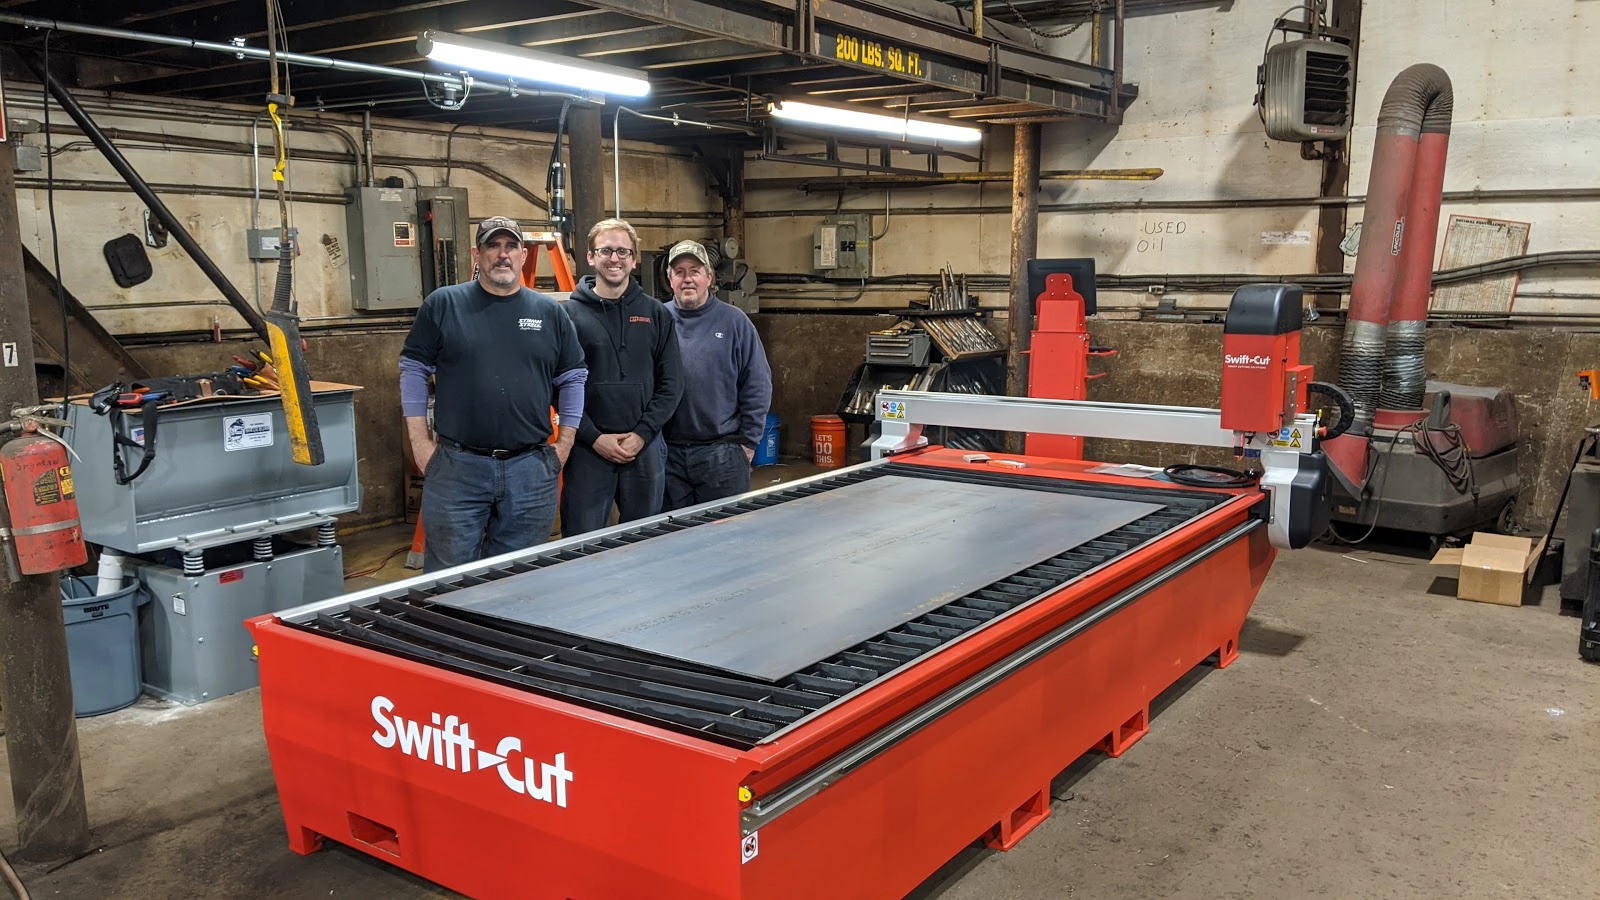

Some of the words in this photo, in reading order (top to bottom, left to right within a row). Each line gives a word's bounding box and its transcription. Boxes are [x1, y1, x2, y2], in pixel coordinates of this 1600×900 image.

[836, 33, 859, 62] 200
[861, 40, 885, 68] LBS.
[887, 46, 905, 73] SQ.
[908, 51, 922, 76] FT.
[1144, 221, 1187, 234] USED
[1393, 222, 1401, 254] LINCOLN
[5, 345, 13, 363] 7
[815, 434, 833, 442] LET'S
[815, 442, 833, 455] DO
[816, 455, 834, 463] THIS.
